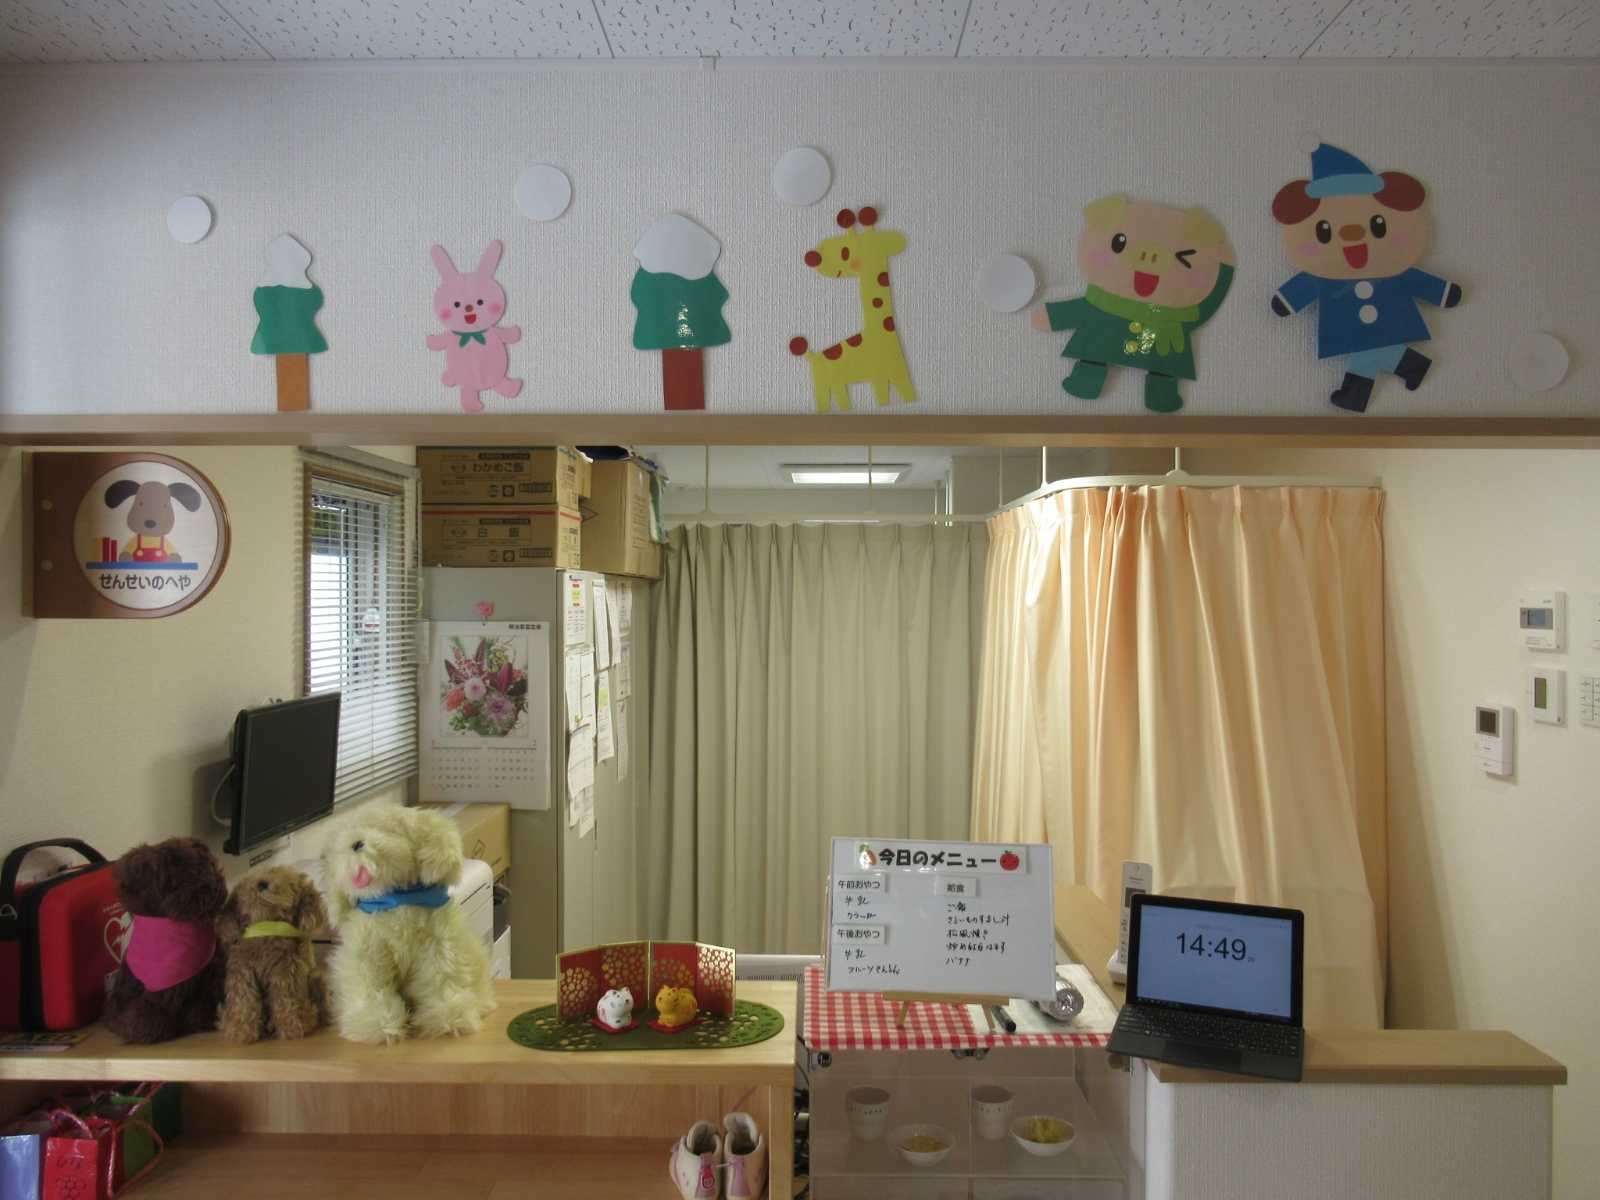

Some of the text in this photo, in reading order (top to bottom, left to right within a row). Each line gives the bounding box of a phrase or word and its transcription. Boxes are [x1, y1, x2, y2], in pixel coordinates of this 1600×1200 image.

[99, 573, 192, 591] せんせいのへや
[878, 848, 997, 868] 今日のメニュー
[838, 880, 881, 889] 午前おやつ
[837, 929, 881, 939] 午後おやつ
[1176, 932, 1247, 961] 14:49
